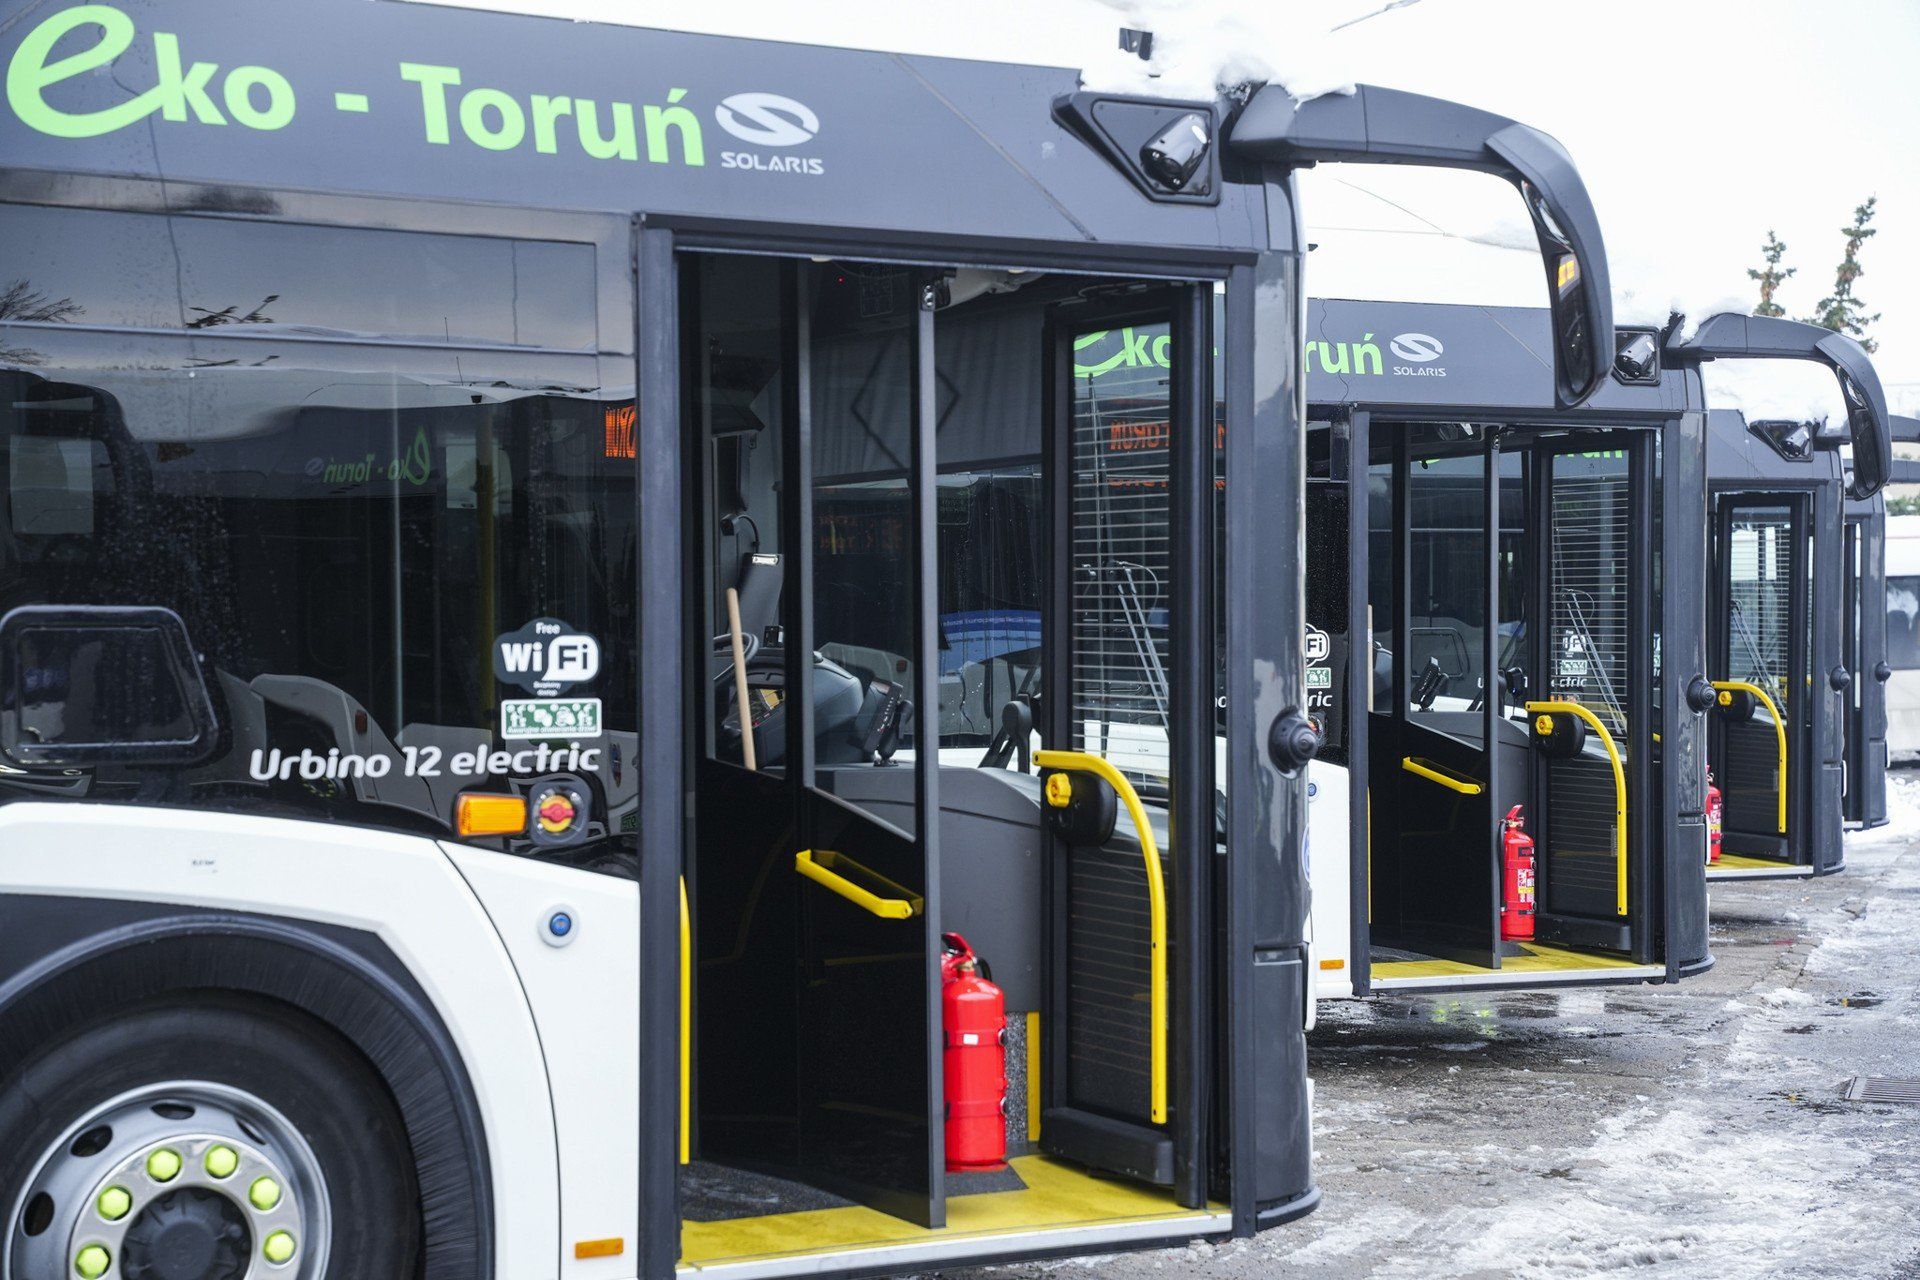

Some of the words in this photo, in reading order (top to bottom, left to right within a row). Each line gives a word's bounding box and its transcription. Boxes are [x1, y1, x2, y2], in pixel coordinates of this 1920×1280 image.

[7, 5, 296, 137] eko
[401, 62, 705, 167] Toruń
[720, 151, 825, 175] SOLARIS
[1305, 332, 1383, 375] ruń
[1393, 366, 1447, 377] SOLARIS
[535, 622, 561, 635] Free
[1551, 676, 1588, 688] ctric
[249, 748, 392, 780] Urbino
[401, 745, 442, 777] 12
[449, 741, 602, 776] electric
